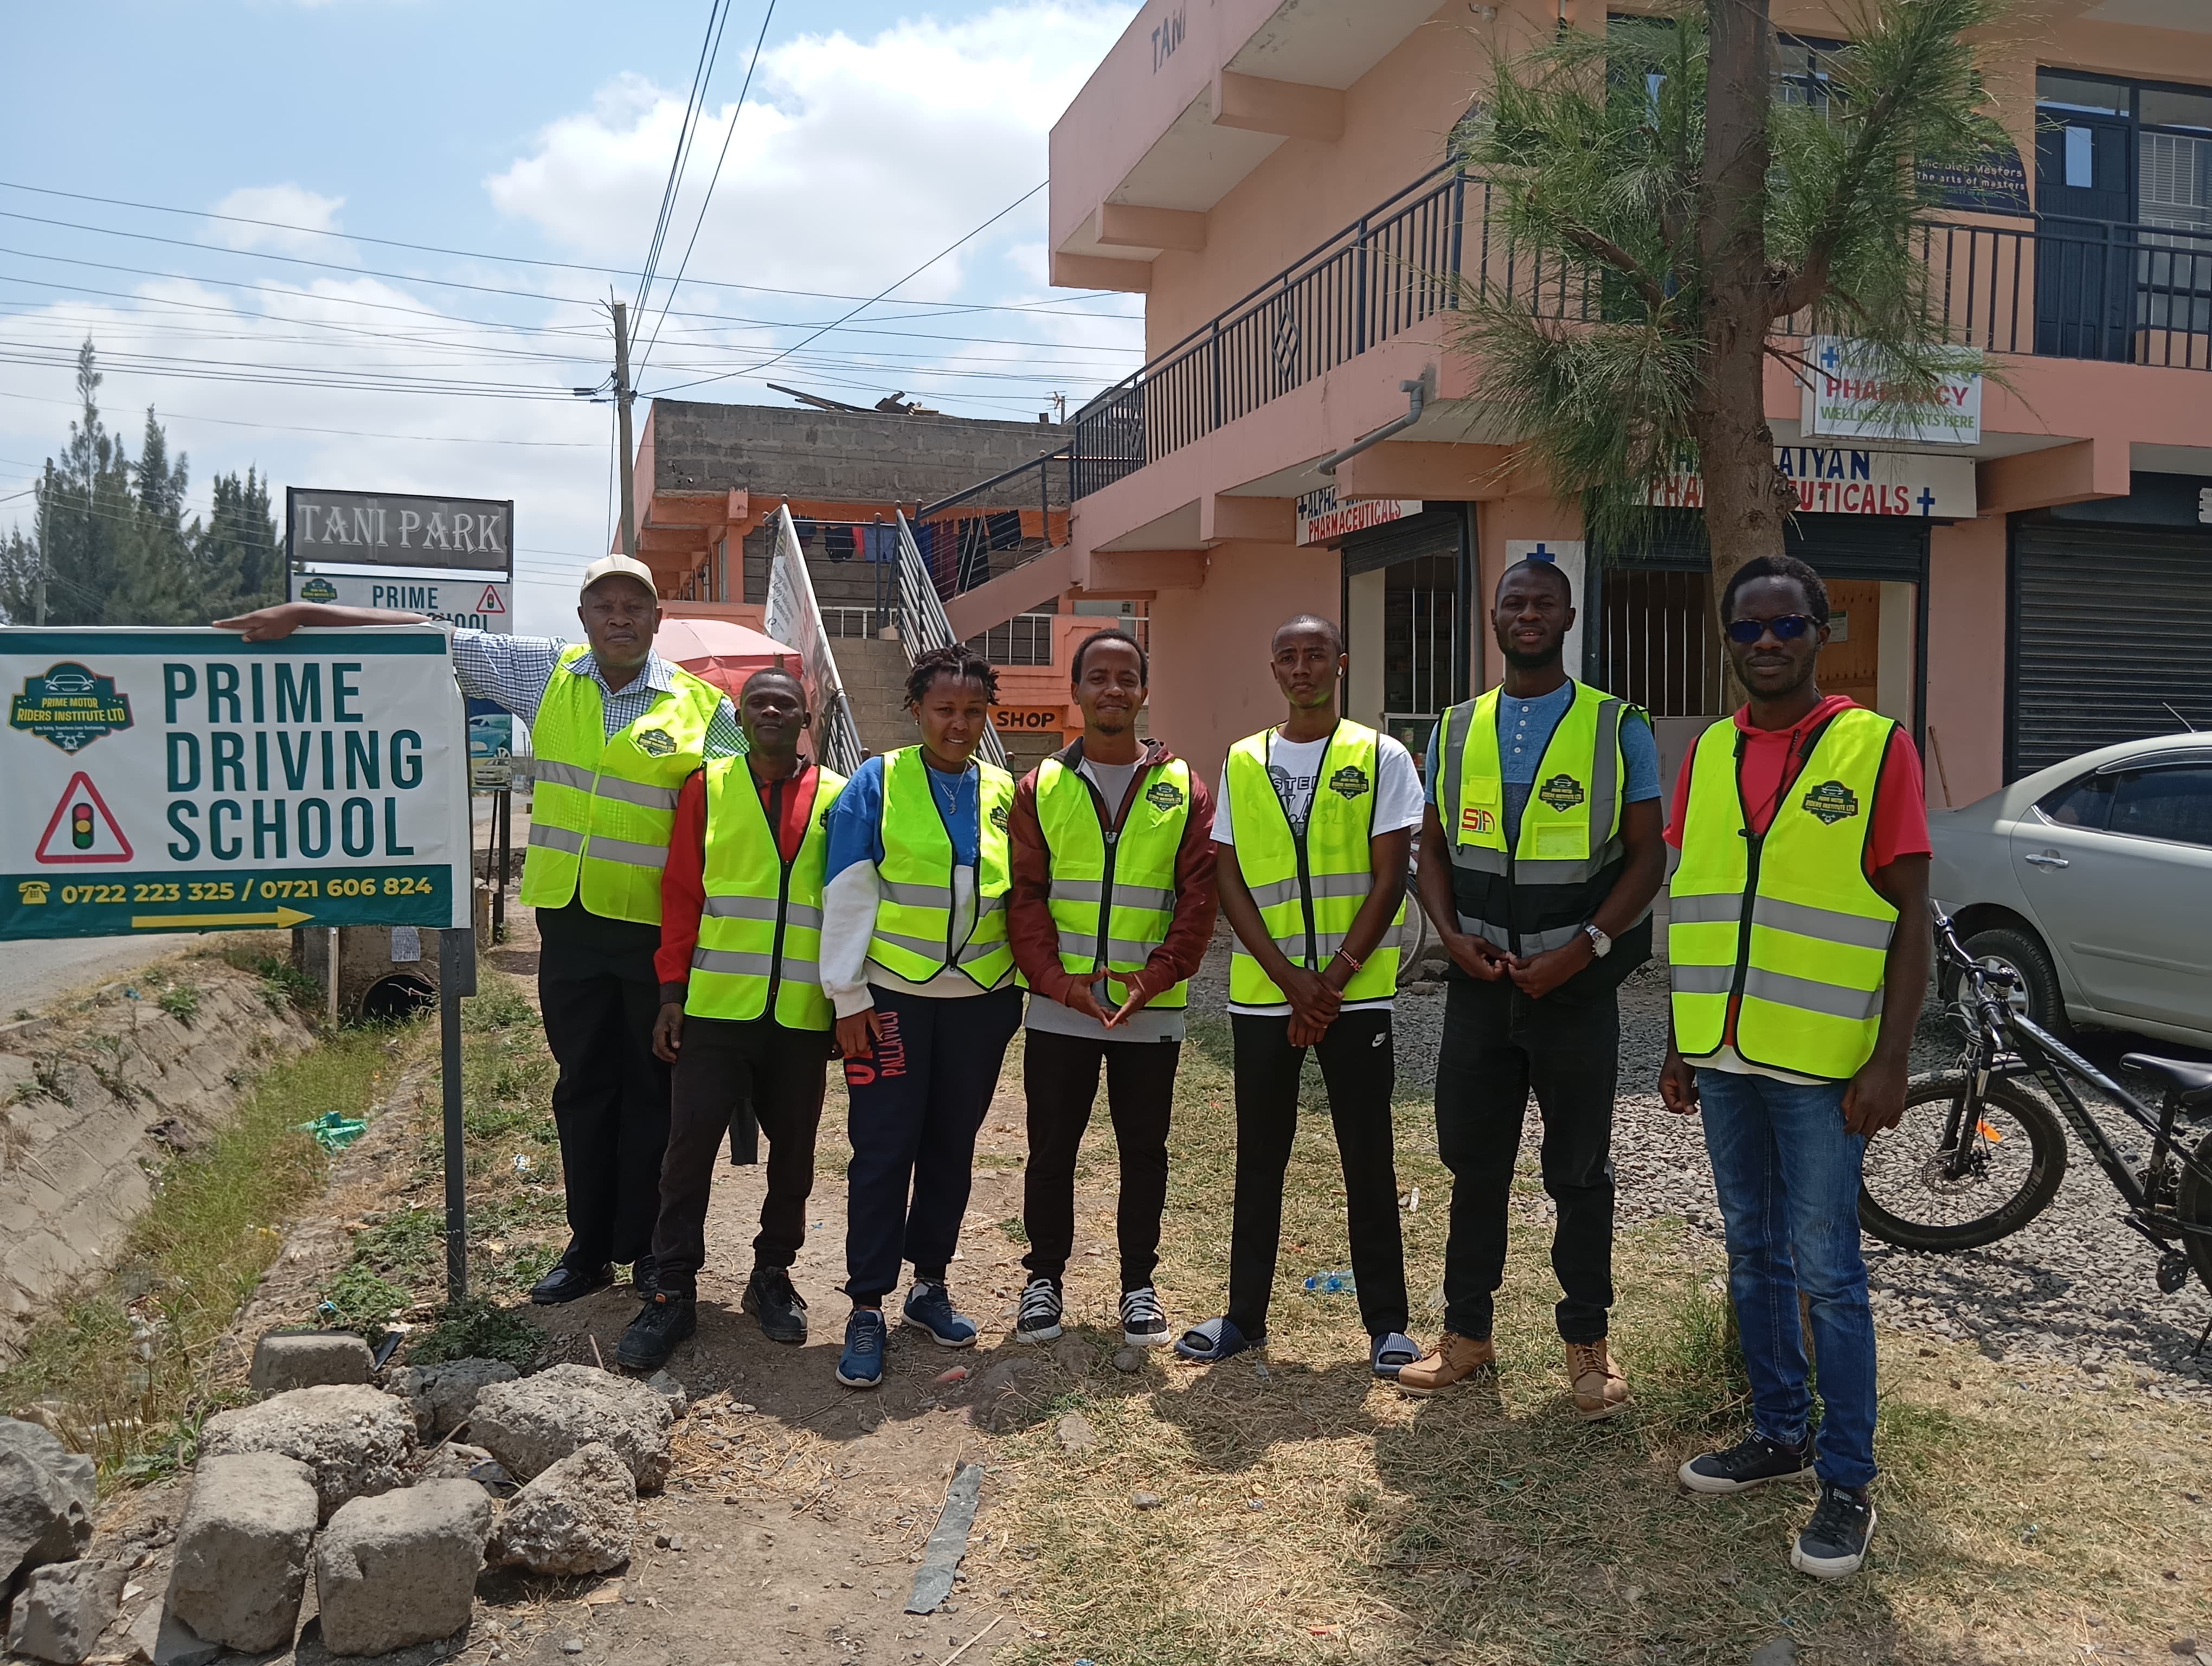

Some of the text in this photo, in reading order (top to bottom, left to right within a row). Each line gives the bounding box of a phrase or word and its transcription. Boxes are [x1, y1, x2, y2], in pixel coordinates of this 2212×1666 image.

[1917, 171, 1934, 180] The
[1940, 175, 1962, 184] arts
[1982, 180, 2025, 190] masters
[1827, 377, 1969, 406] PHACY
[1945, 415, 1975, 428] HERE
[1648, 476, 1909, 515] PHAUTICALS
[297, 504, 505, 554] TANI PARK
[1309, 499, 1401, 542] PHARMACEUTICALS
[372, 585, 439, 609] PRIME
[42, 697, 99, 708] PRIME MOTOR
[163, 662, 364, 723] PRIME
[17, 708, 125, 721] RIDERS INSTITUTE LTD
[996, 711, 1055, 728] SHOP
[166, 729, 423, 792] DRIVING
[167, 797, 415, 861] SCHOOL
[61, 877, 433, 904] 0722 223 325 / 0721 606 824
